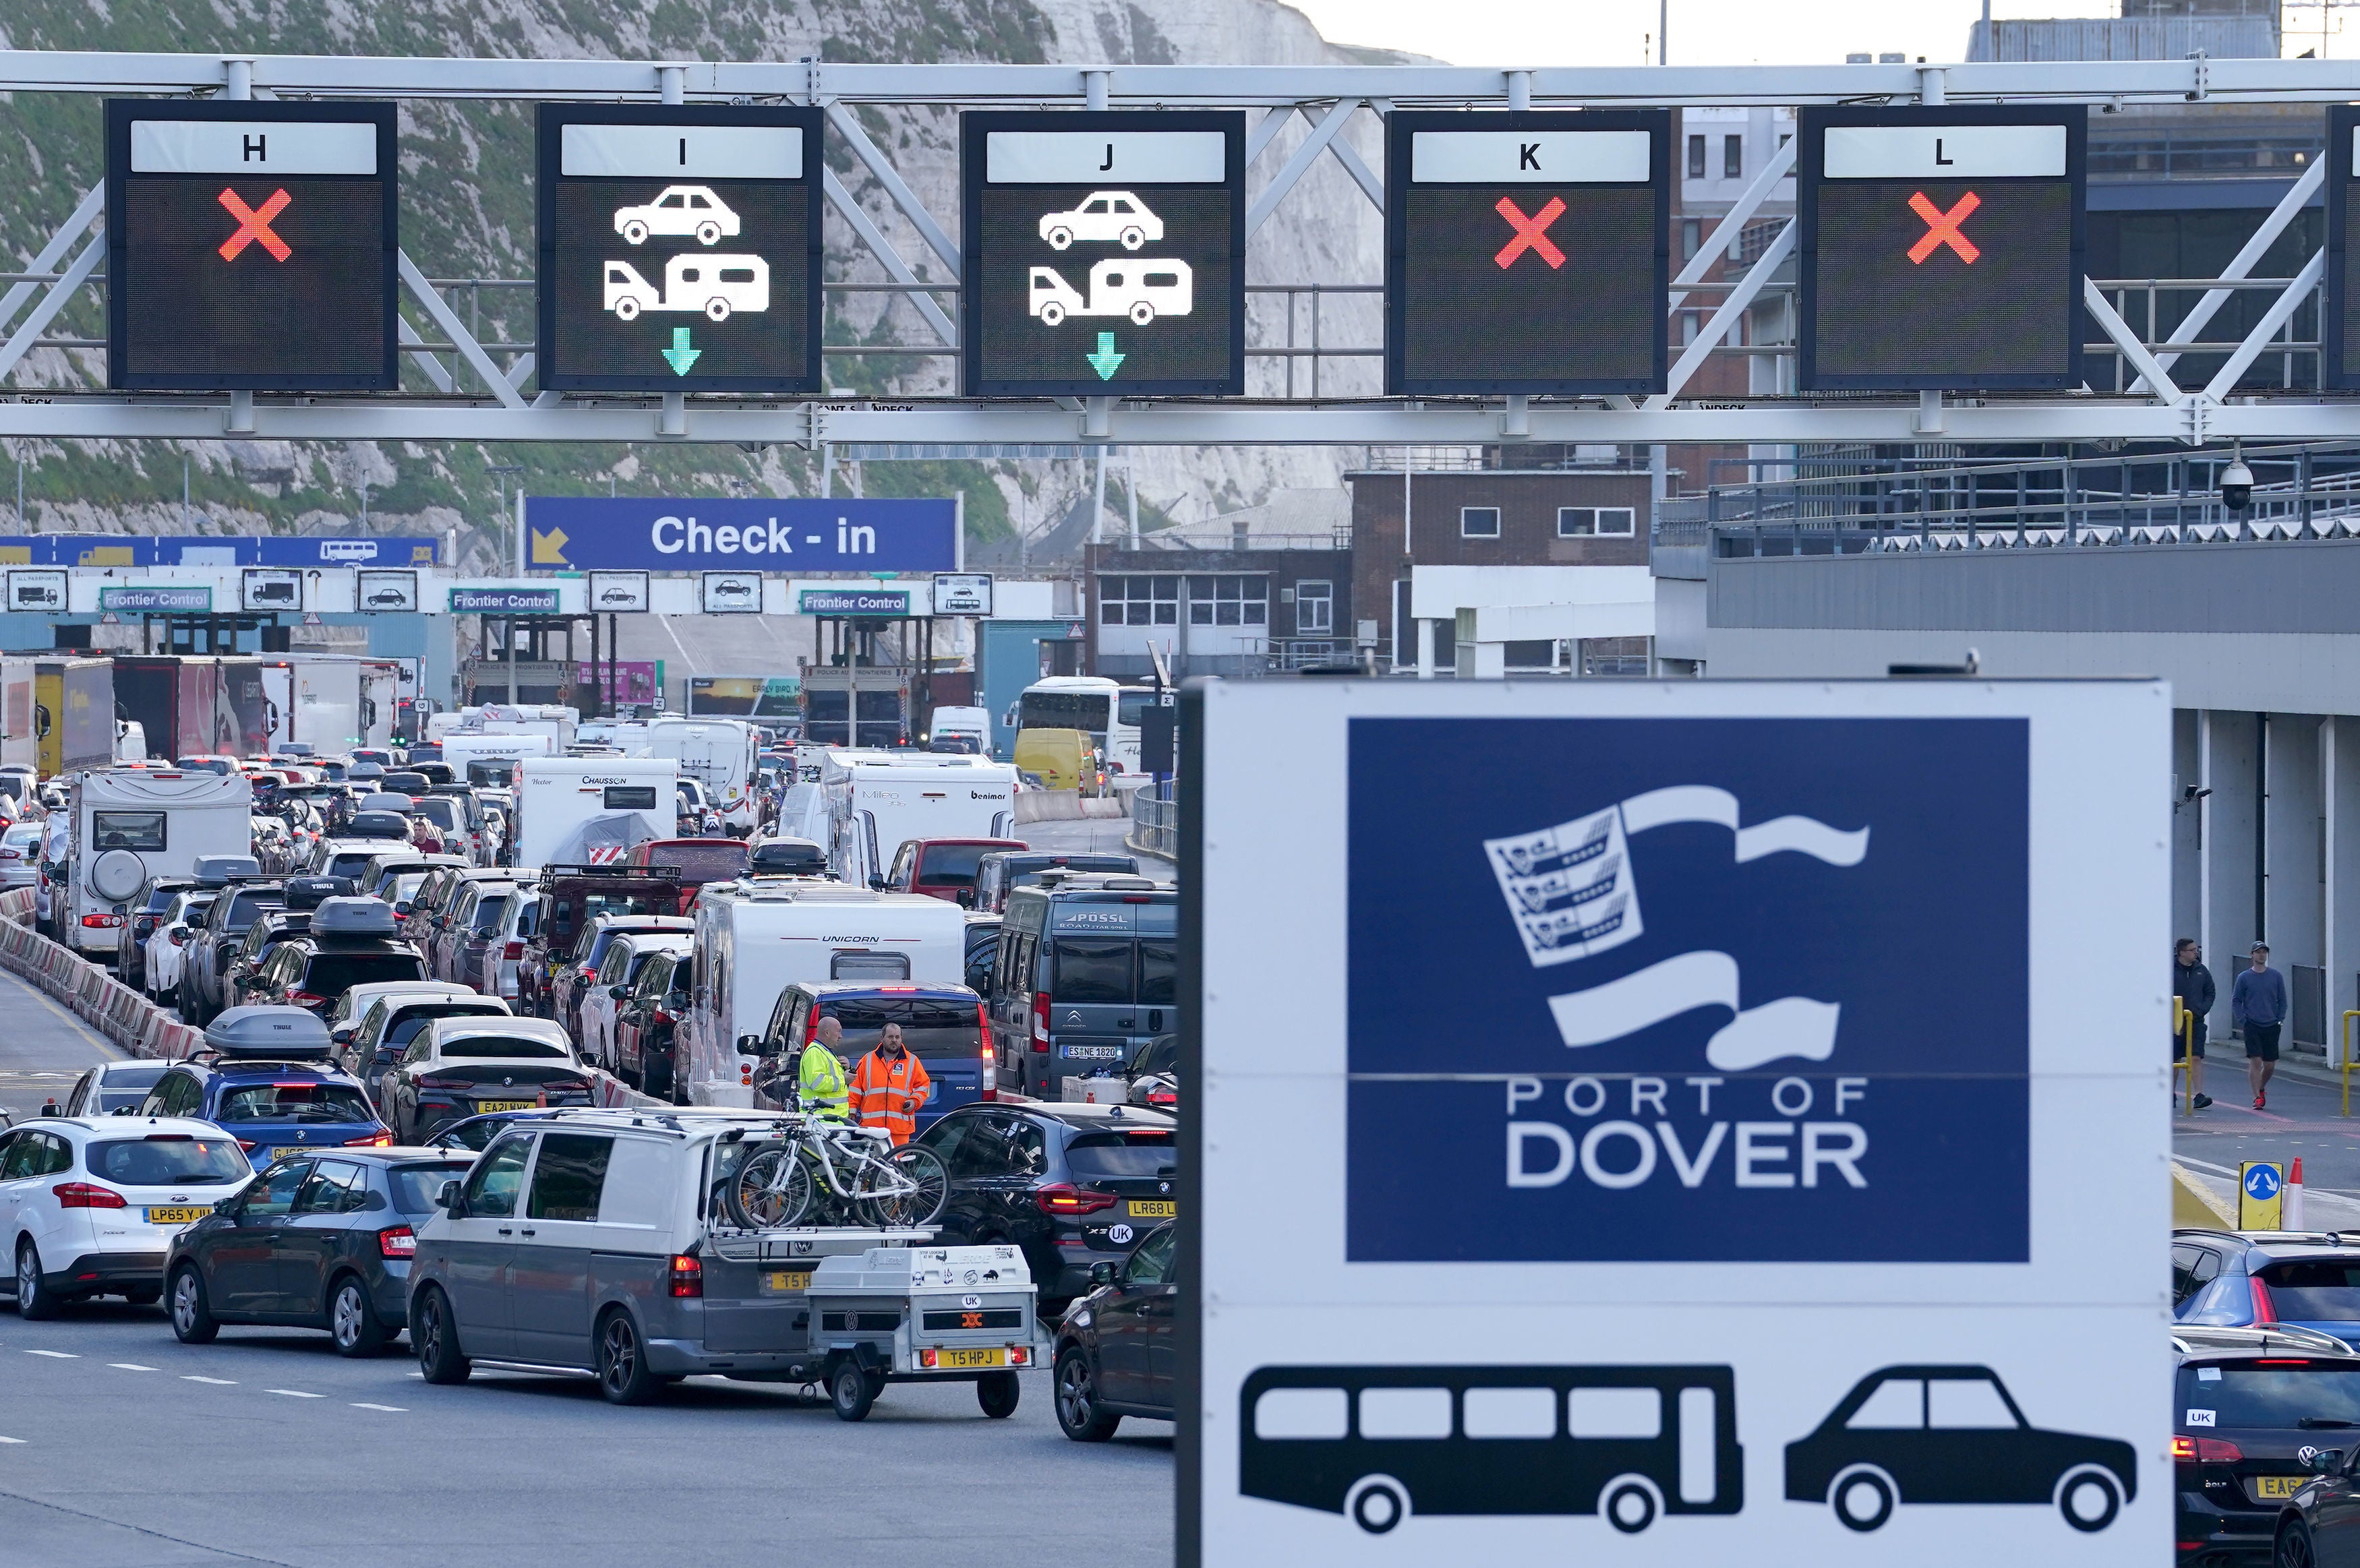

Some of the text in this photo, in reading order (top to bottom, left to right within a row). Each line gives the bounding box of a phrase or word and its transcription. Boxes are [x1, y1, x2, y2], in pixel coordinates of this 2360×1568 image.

[243, 135, 265, 161] H
[680, 139, 685, 165] I
[1936, 139, 1953, 165] L
[1100, 145, 1114, 171] J
[1523, 144, 1541, 170] K
[652, 516, 875, 553] Check - in
[106, 593, 207, 605] Frontier Control
[454, 595, 555, 607] Frontier Control
[805, 596, 906, 609] Frontier Control
[582, 776, 626, 784] CHAUSSON
[862, 789, 899, 799] Mileo
[971, 790, 1006, 800] benimar
[1078, 912, 1128, 923] PÖSSL
[1069, 1048, 1115, 1057] ES NE 1820
[1508, 1077, 1868, 1116] PORT OF
[1507, 1120, 1868, 1188] DOVER
[152, 1209, 183, 1220] LP65
[1133, 1203, 1164, 1214] LR68
[1112, 1228, 1129, 1240] UK
[782, 1275, 800, 1288] T5
[966, 1297, 977, 1305] UK
[951, 1351, 966, 1364] T5
[2191, 1413, 2210, 1422] UK
[2266, 1478, 2307, 1495] EA6
